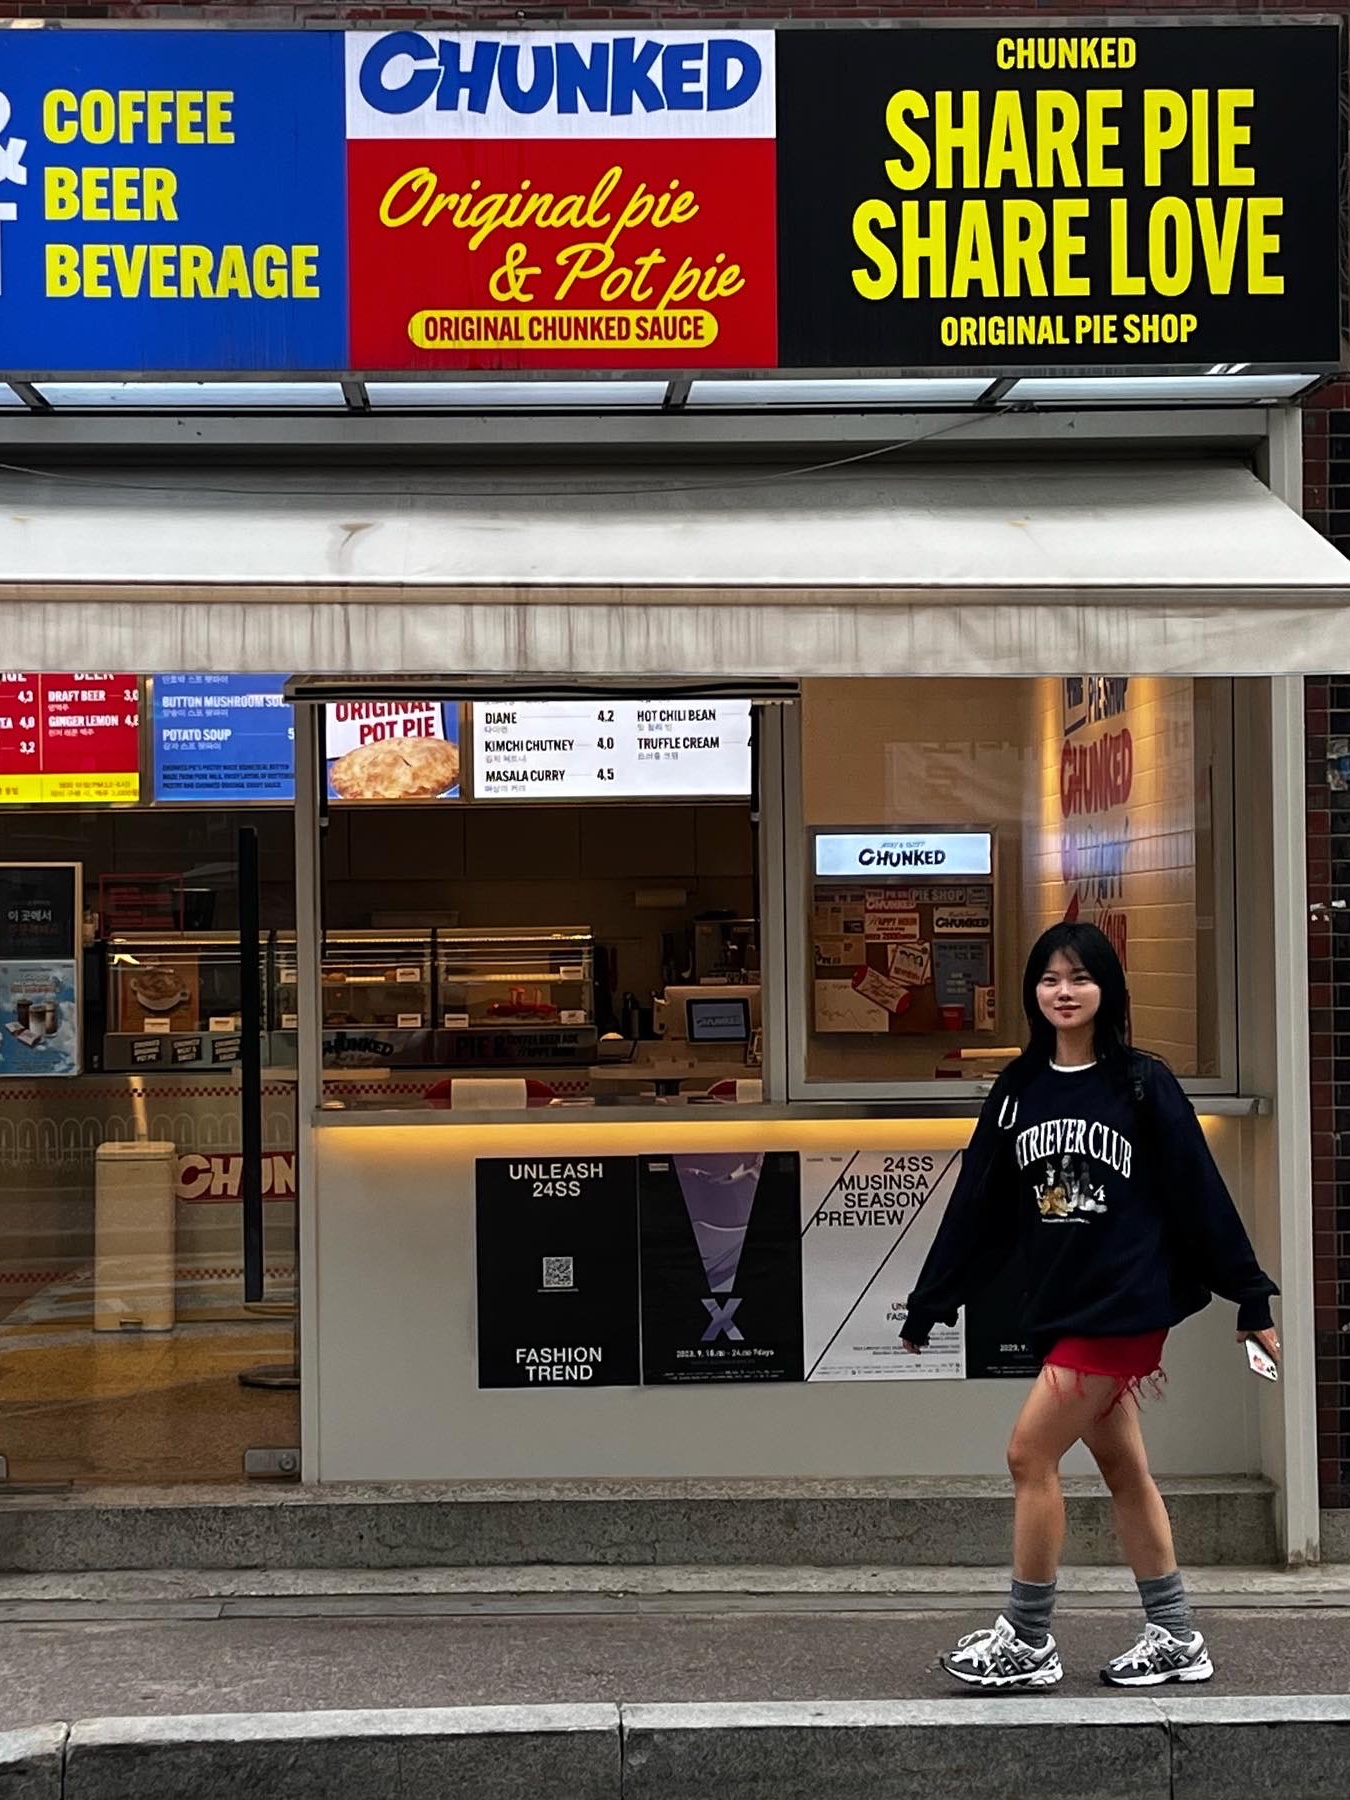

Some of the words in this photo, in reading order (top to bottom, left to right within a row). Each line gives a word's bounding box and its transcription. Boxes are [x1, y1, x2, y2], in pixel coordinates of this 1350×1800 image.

[996, 37, 1137, 70] CHUNKED
[358, 31, 762, 117] CHUNKED
[43, 89, 235, 145] COFFEE
[885, 89, 1124, 191] SHARE
[1144, 88, 1255, 188] PIE
[44, 167, 178, 221] BEER
[380, 165, 612, 251] Original
[604, 178, 700, 250] pie
[851, 198, 1091, 301] SHARE
[1110, 196, 1285, 298] LOVE
[45, 244, 320, 299] BEVERAGE
[489, 242, 542, 303] &
[555, 242, 666, 302] Pot
[656, 252, 746, 313] pie
[424, 317, 524, 343] ORIGINAL
[527, 316, 631, 341] CHUNKED
[635, 315, 705, 340] SAUCE
[941, 315, 1069, 347] ORIGINAL
[1075, 314, 1118, 344] PIE
[1122, 313, 1197, 344] SHOP
[48, 690, 79, 702] DRAFT
[81, 690, 106, 701] BEER
[162, 696, 202, 708] BUTTON
[204, 695, 264, 708] MUSHROOM
[265, 694, 290, 708] SOU
[48, 716, 84, 728] GINGER
[85, 715, 119, 727] LEMON
[485, 712, 518, 725] DIANE
[637, 711, 658, 722] HOT
[659, 711, 687, 722] CHILI
[688, 709, 716, 722] BEAN
[162, 728, 201, 741] POTATO
[202, 728, 232, 741] SOUP
[360, 720, 398, 745] POT
[402, 716, 436, 738] PIE
[484, 740, 525, 753] KIMCHI
[525, 739, 575, 752] CHUTNEY
[637, 738, 682, 750] TRUFFLE
[682, 736, 720, 749] CREAM
[485, 770, 529, 783] MASALA
[530, 769, 566, 782] CURRY
[1060, 727, 1132, 819] CHUNKED
[858, 847, 947, 868] CHUNKED
[1088, 1121, 1132, 1179] CLUB
[509, 1162, 604, 1180] UNLEASH
[883, 1156, 934, 1173] 24SS
[532, 1180, 581, 1197] 24SS
[839, 1174, 929, 1191] MUSINSA
[844, 1192, 924, 1209] SEASON
[816, 1210, 905, 1227] PREVIEW
[515, 1347, 602, 1364] FASHION
[525, 1364, 593, 1381] TREND
